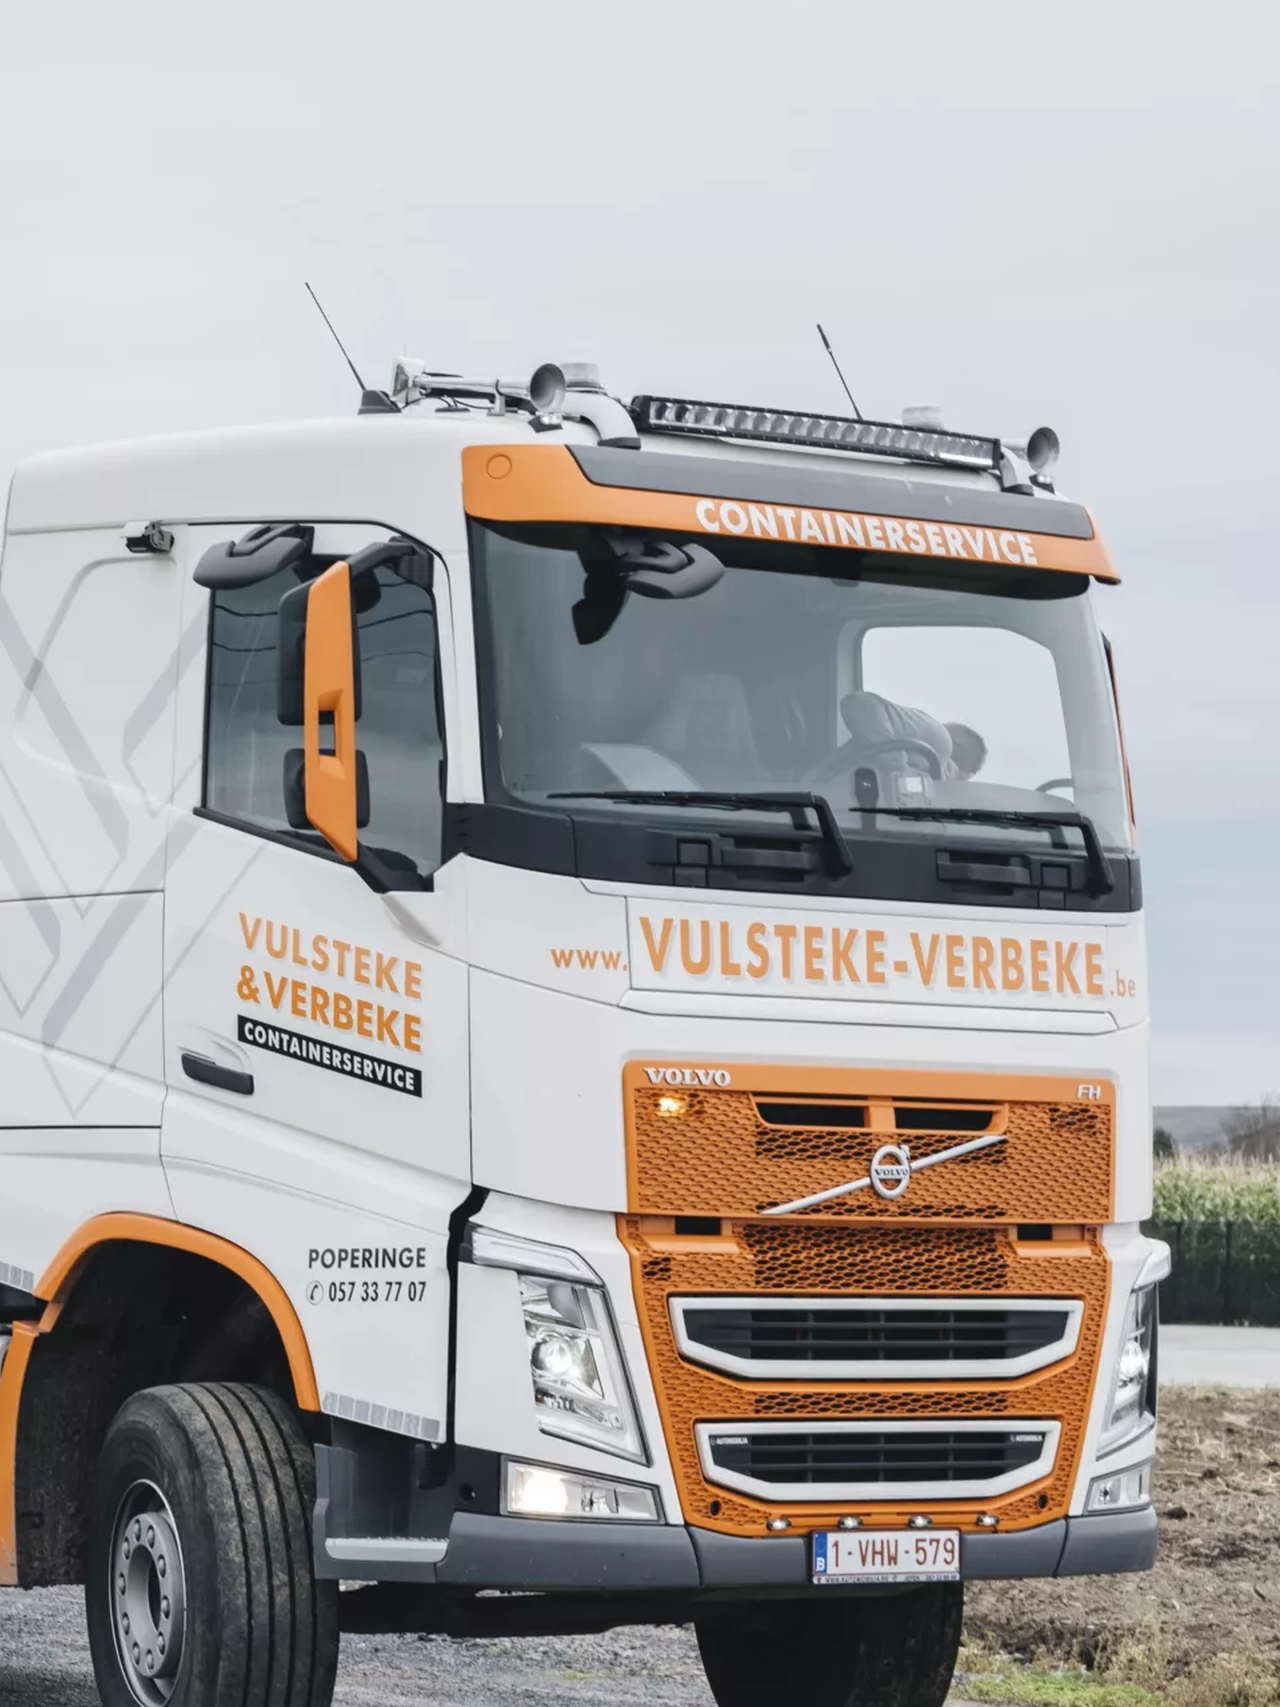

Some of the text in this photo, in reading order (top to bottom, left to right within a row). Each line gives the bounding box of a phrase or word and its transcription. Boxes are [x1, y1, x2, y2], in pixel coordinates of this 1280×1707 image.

[696, 500, 1038, 565] CONTAINERSERVICE
[238, 912, 422, 1000] VULSTEKE
[243, 1021, 415, 1091] CONTAINERSERVICE
[644, 1066, 732, 1087] VOLVO
[1076, 1084, 1102, 1100] FH
[874, 1168, 909, 1176] VOLVO
[308, 1247, 426, 1269] POPERINGE
[328, 1281, 427, 1302] 057 33 77 07
[816, 1557, 825, 1571] B
